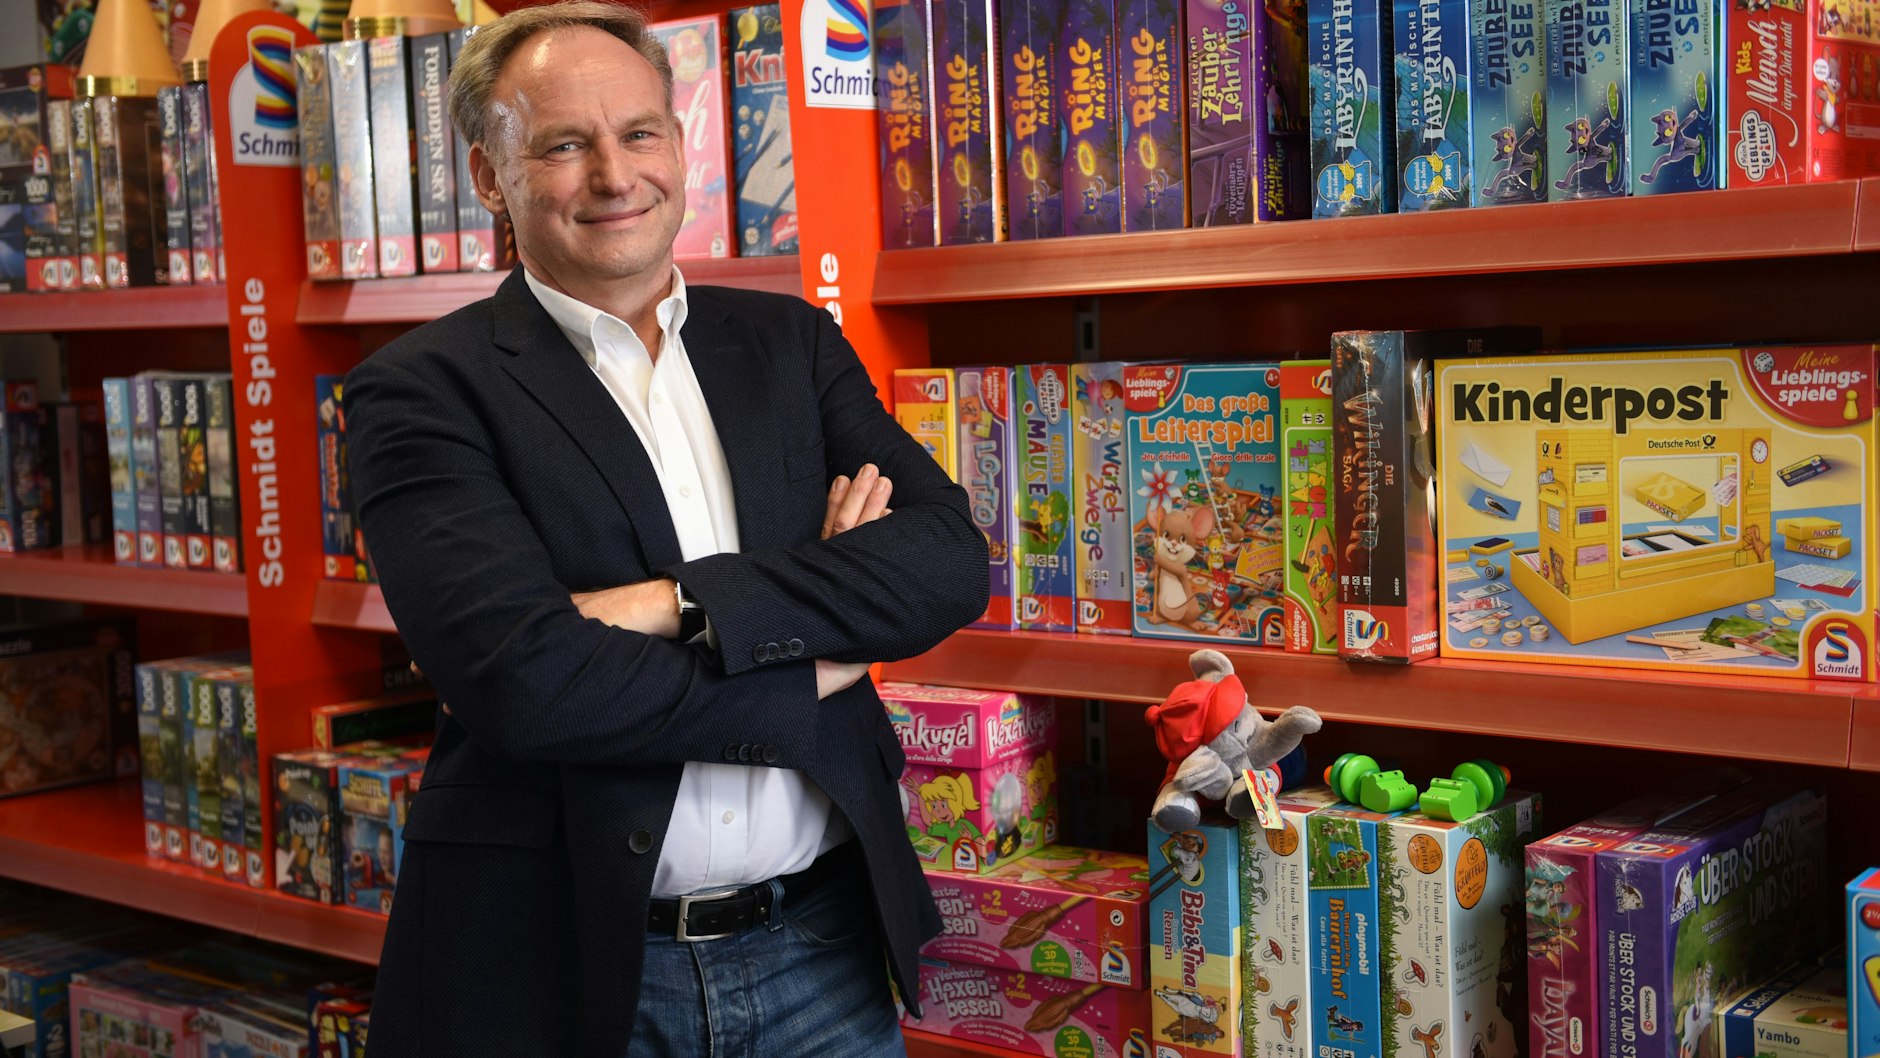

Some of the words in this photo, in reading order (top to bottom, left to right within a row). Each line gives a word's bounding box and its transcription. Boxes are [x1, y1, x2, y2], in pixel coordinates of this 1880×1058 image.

[1510, 2, 1535, 58] SEE
[1779, 17, 1793, 47] nicht
[1190, 36, 1199, 85] Kleinen
[1219, 1, 1247, 126] Lehrlinge
[1321, 22, 1333, 101] MAGISCHE
[1408, 10, 1420, 92] MAGISCHE
[1638, 49, 1646, 65] DER
[1735, 41, 1752, 75] Kids
[1779, 48, 1793, 77] Dich
[1156, 38, 1170, 112] MAGIER
[1200, 27, 1224, 120] Zauber
[1478, 69, 1486, 87] DER
[1552, 60, 1560, 76] DER
[1036, 55, 1050, 126] MAGIER
[1089, 75, 1097, 97] DER
[1092, 47, 1106, 120] MAGIER
[424, 46, 444, 160] FORBIDDEN
[908, 71, 922, 139] MAGIER
[968, 64, 982, 134] MAGIER
[1191, 90, 1200, 108] Die
[1324, 109, 1332, 135] DAS
[1411, 99, 1419, 126] DAS
[1747, 117, 1760, 175] LIEBLINGS
[1759, 126, 1771, 164] SPIELE
[431, 164, 446, 203] SKY
[1444, 164, 1452, 181] 2009
[240, 277, 276, 407] Spiele
[1793, 350, 1840, 371] Meine
[1126, 378, 1170, 390] Lieblings-
[1267, 372, 1279, 382] 4+
[1770, 368, 1868, 389] Lieblings-
[1046, 374, 1058, 419] LIEBLINGS
[1130, 388, 1158, 400] spiele
[1183, 392, 1215, 413] Das
[1219, 392, 1269, 419] große
[1453, 377, 1729, 435] Kinderpost
[1778, 386, 1838, 407] spiele
[1138, 414, 1275, 452] Leiterspiel
[1648, 440, 1684, 449] Deutsche
[1684, 439, 1700, 448] Post
[1024, 419, 1049, 497] MÄUSE
[1141, 452, 1156, 462] Jeu
[1211, 452, 1233, 462] Gioco
[1235, 451, 1253, 462] delle
[1256, 452, 1277, 462] scale
[971, 440, 1002, 527] LOTTO
[1342, 455, 1354, 495] SAGA
[1384, 464, 1395, 486] DIE
[250, 418, 284, 588] Schmidt
[1646, 499, 1675, 519] PACKSET
[1081, 471, 1104, 562] Zwerge
[1812, 527, 1840, 538] PACKSET
[1798, 543, 1835, 557] PACKSET
[1293, 606, 1302, 651] Lieblings-
[1300, 620, 1308, 648] spiele
[1346, 611, 1355, 647] Schmidt
[1816, 662, 1860, 675] Schmidt
[956, 861, 976, 869] Schmidt
[1289, 863, 1298, 885] Fühl
[1700, 848, 1739, 905] ÜBER
[1742, 818, 1794, 884] STOCK
[992, 889, 1002, 906] 2
[1290, 888, 1299, 904] mal
[1433, 881, 1443, 904] Fühl
[1291, 914, 1299, 931] Was
[1434, 907, 1444, 924] mal
[1163, 909, 1174, 960] Rennen
[1181, 888, 1206, 990] Bibi&Tina
[1291, 934, 1299, 948] ist
[1354, 912, 1370, 976] playmobil
[1434, 934, 1444, 952] Was
[1044, 950, 1057, 960] 3D
[1291, 947, 1300, 966] das?
[1328, 896, 1348, 1000] Bauernhof
[1434, 955, 1443, 966] ist
[1608, 943, 1616, 962] MONTS
[1618, 932, 1636, 965] ÜBER
[1320, 948, 1328, 975] fattoria
[927, 976, 998, 1004] Hexen-
[1016, 973, 1026, 990] 2
[1102, 971, 1130, 983] Schmidt
[1435, 968, 1445, 989] das?
[1619, 967, 1636, 1014] STOCK
[942, 990, 1003, 1018] besen
[1609, 1007, 1617, 1019] PER
[1066, 1035, 1080, 1045] 3D
[1621, 1016, 1637, 1042] UND
[1757, 1027, 1801, 1046] Yambo
[1609, 1042, 1617, 1054] PER
